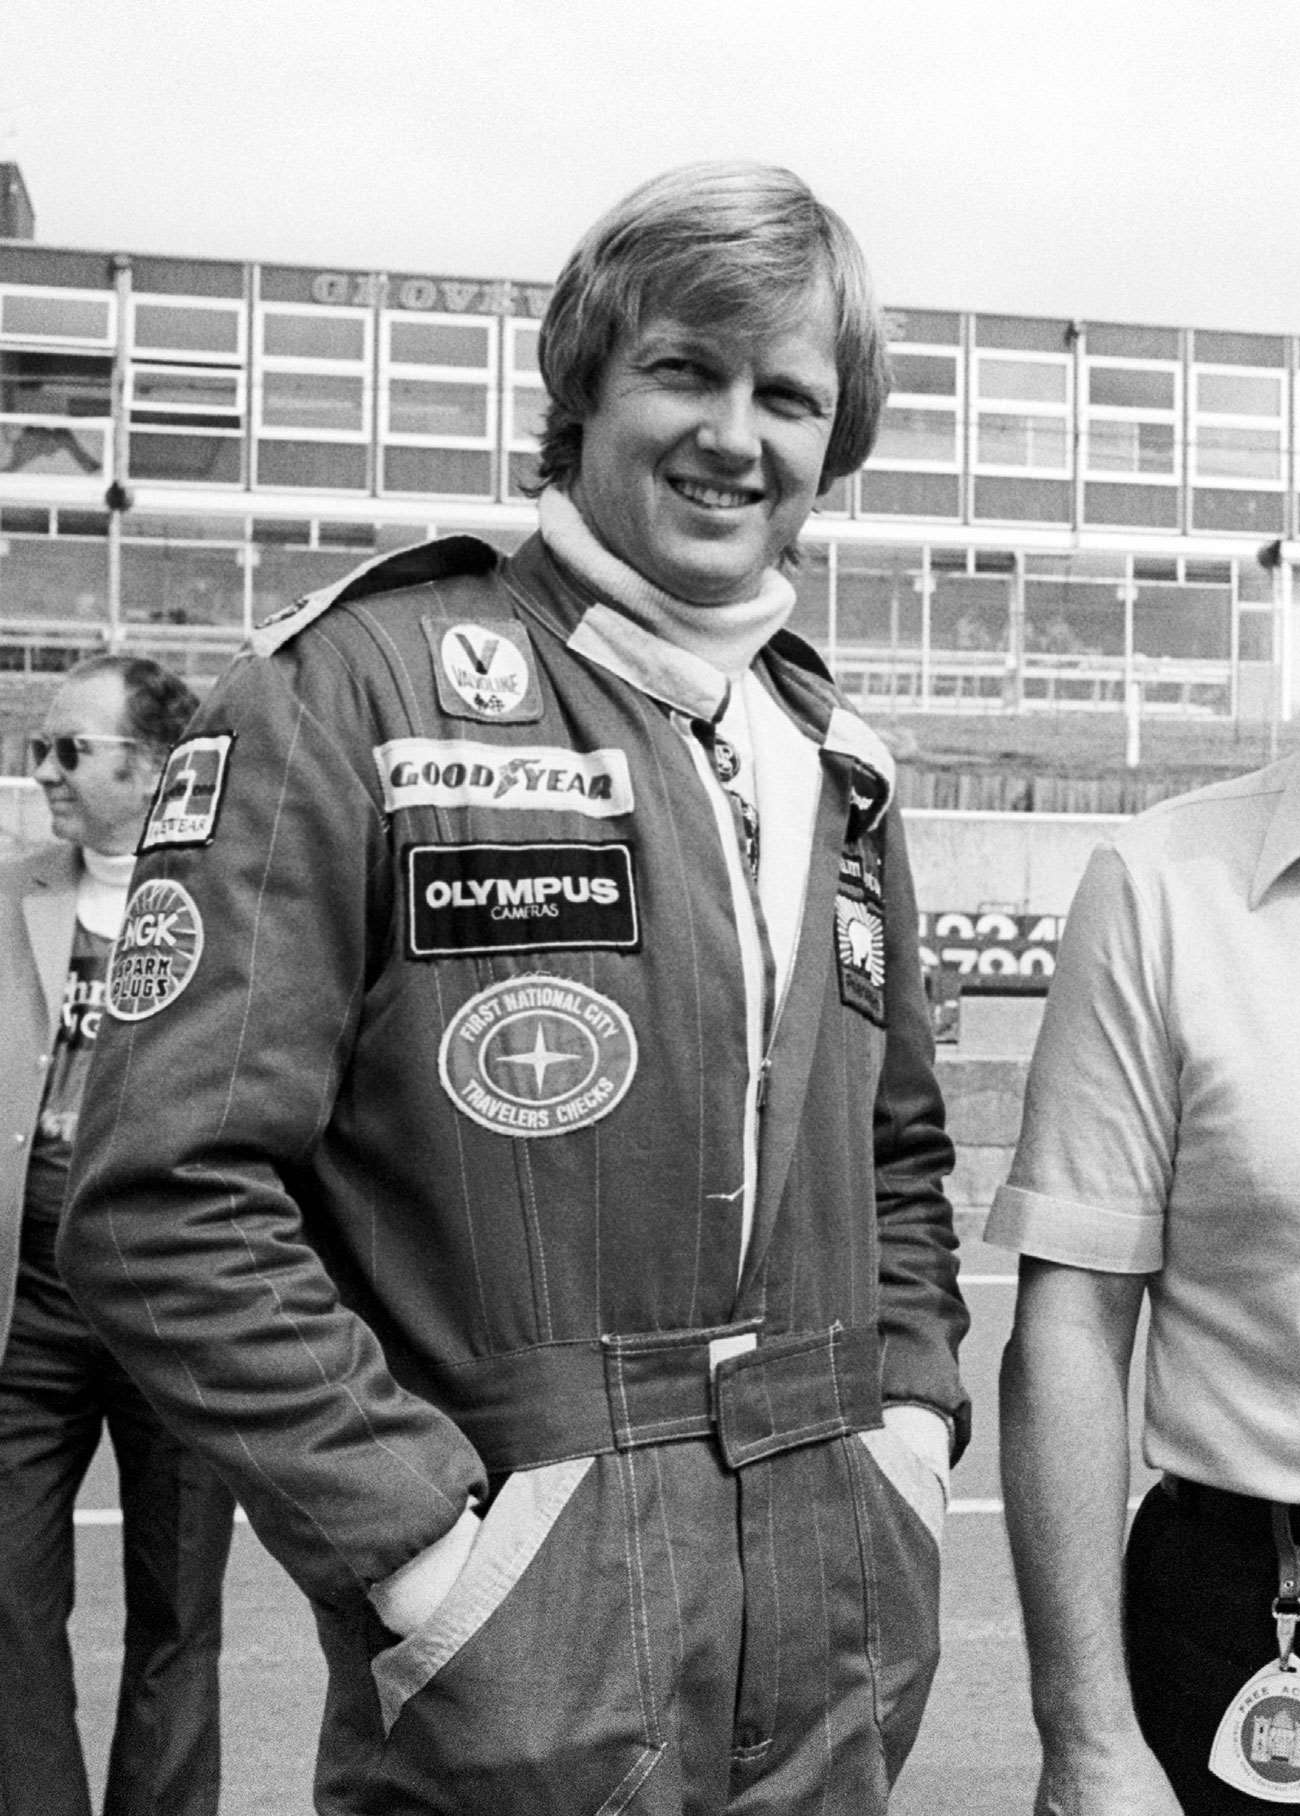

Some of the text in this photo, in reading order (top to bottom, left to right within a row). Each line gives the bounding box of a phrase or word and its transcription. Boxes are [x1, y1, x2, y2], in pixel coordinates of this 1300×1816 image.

[426, 876, 620, 908] OLYMPUS
[491, 903, 559, 920] CAMERAS
[121, 912, 178, 951] NGK
[115, 957, 170, 977] SPARK
[112, 978, 168, 998] PLUGS
[459, 986, 620, 1042] FIRST NATIONAL CITY
[461, 1076, 615, 1128] TRAVELERS CHECKS
[1239, 1686, 1269, 1713] FREE
